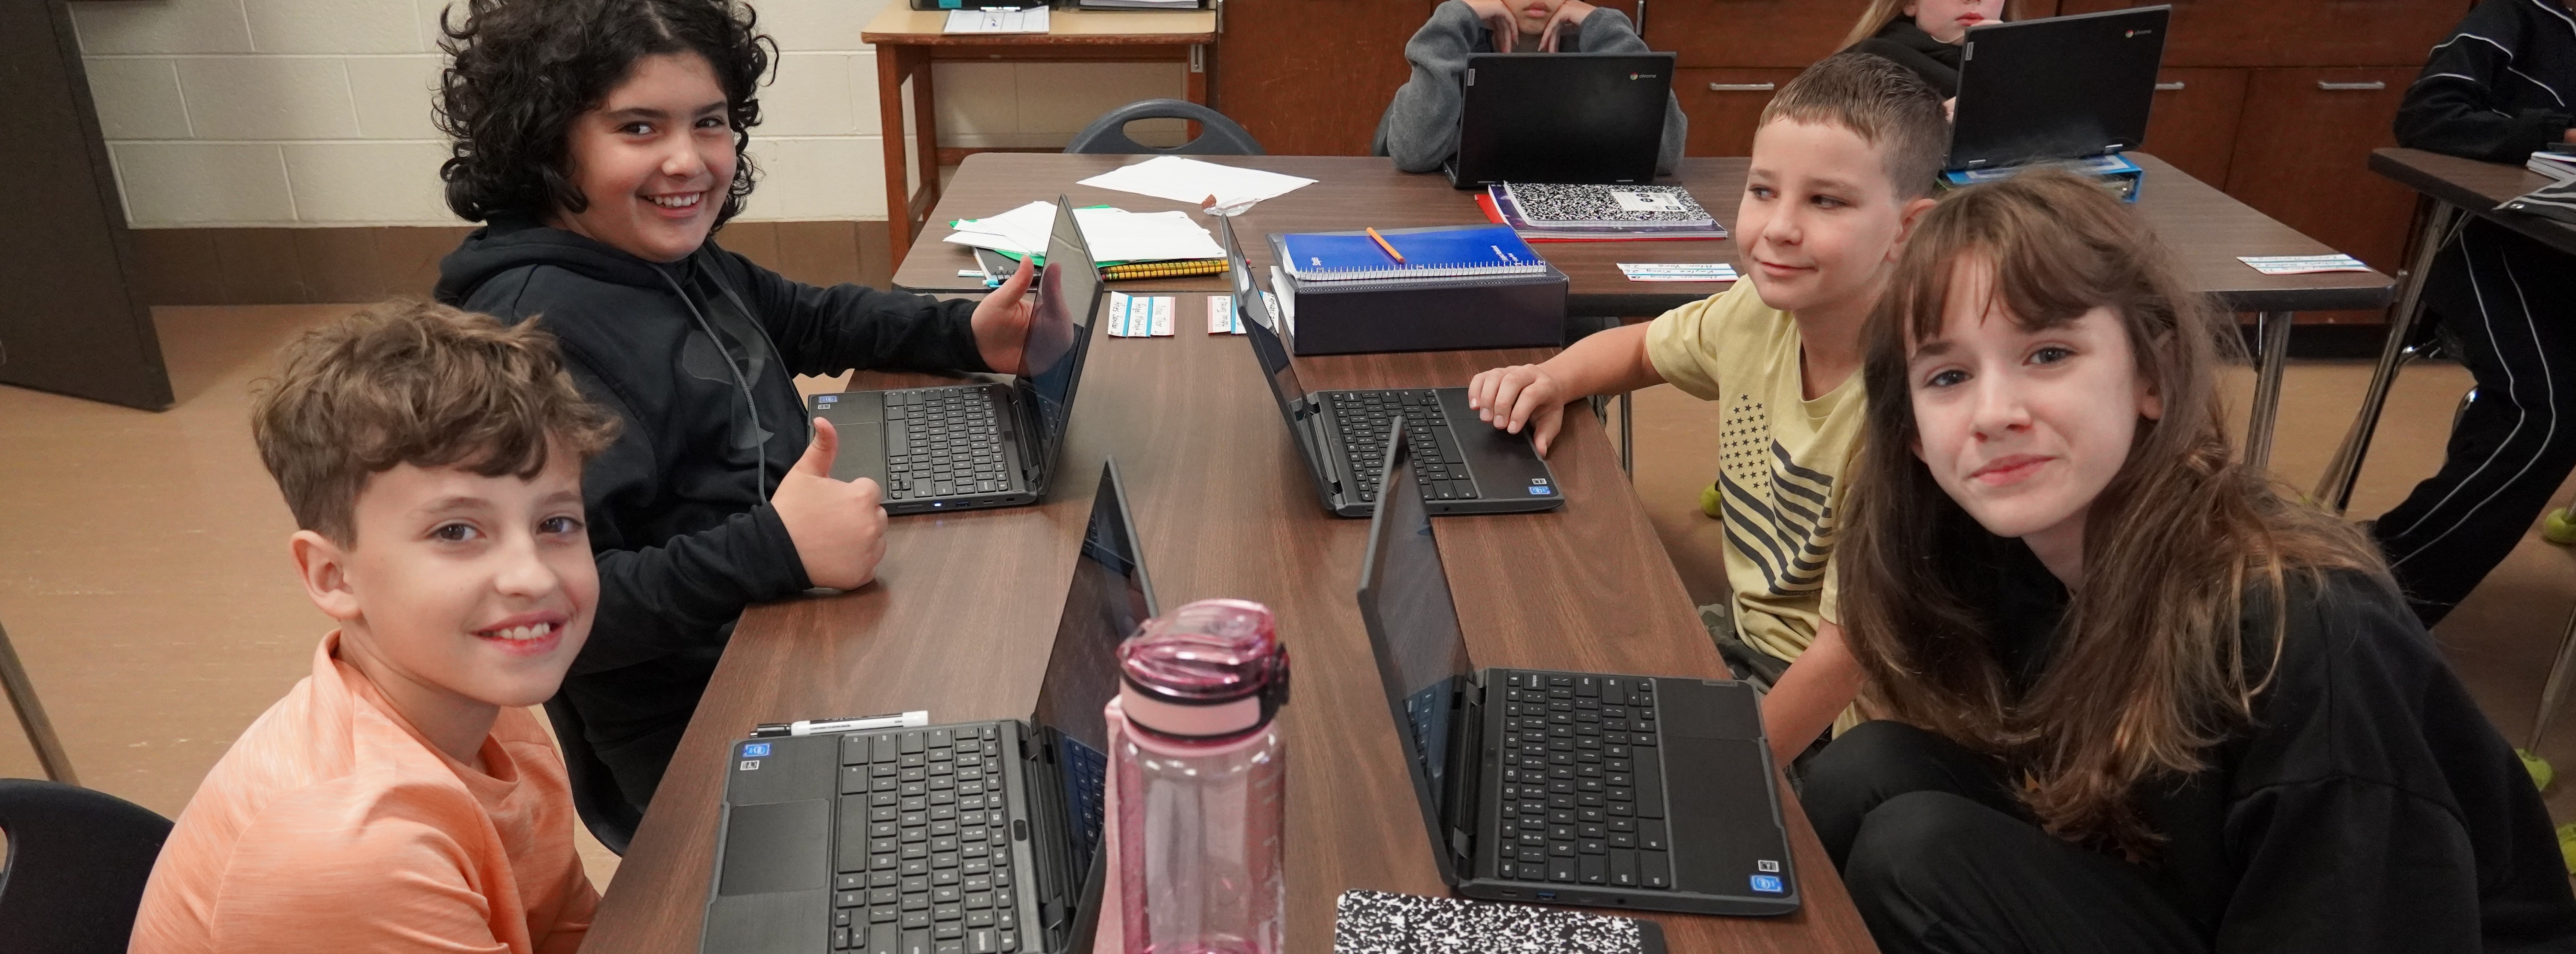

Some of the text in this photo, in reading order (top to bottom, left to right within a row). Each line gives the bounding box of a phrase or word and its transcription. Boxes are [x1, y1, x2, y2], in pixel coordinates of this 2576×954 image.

[1113, 301, 1125, 312] Aries
[1133, 303, 1146, 314] Angel
[1155, 305, 1166, 315] Nova
[1217, 302, 1227, 313] Torres
[1155, 317, 1166, 327] Thor
[1215, 314, 1228, 327] Adrian
